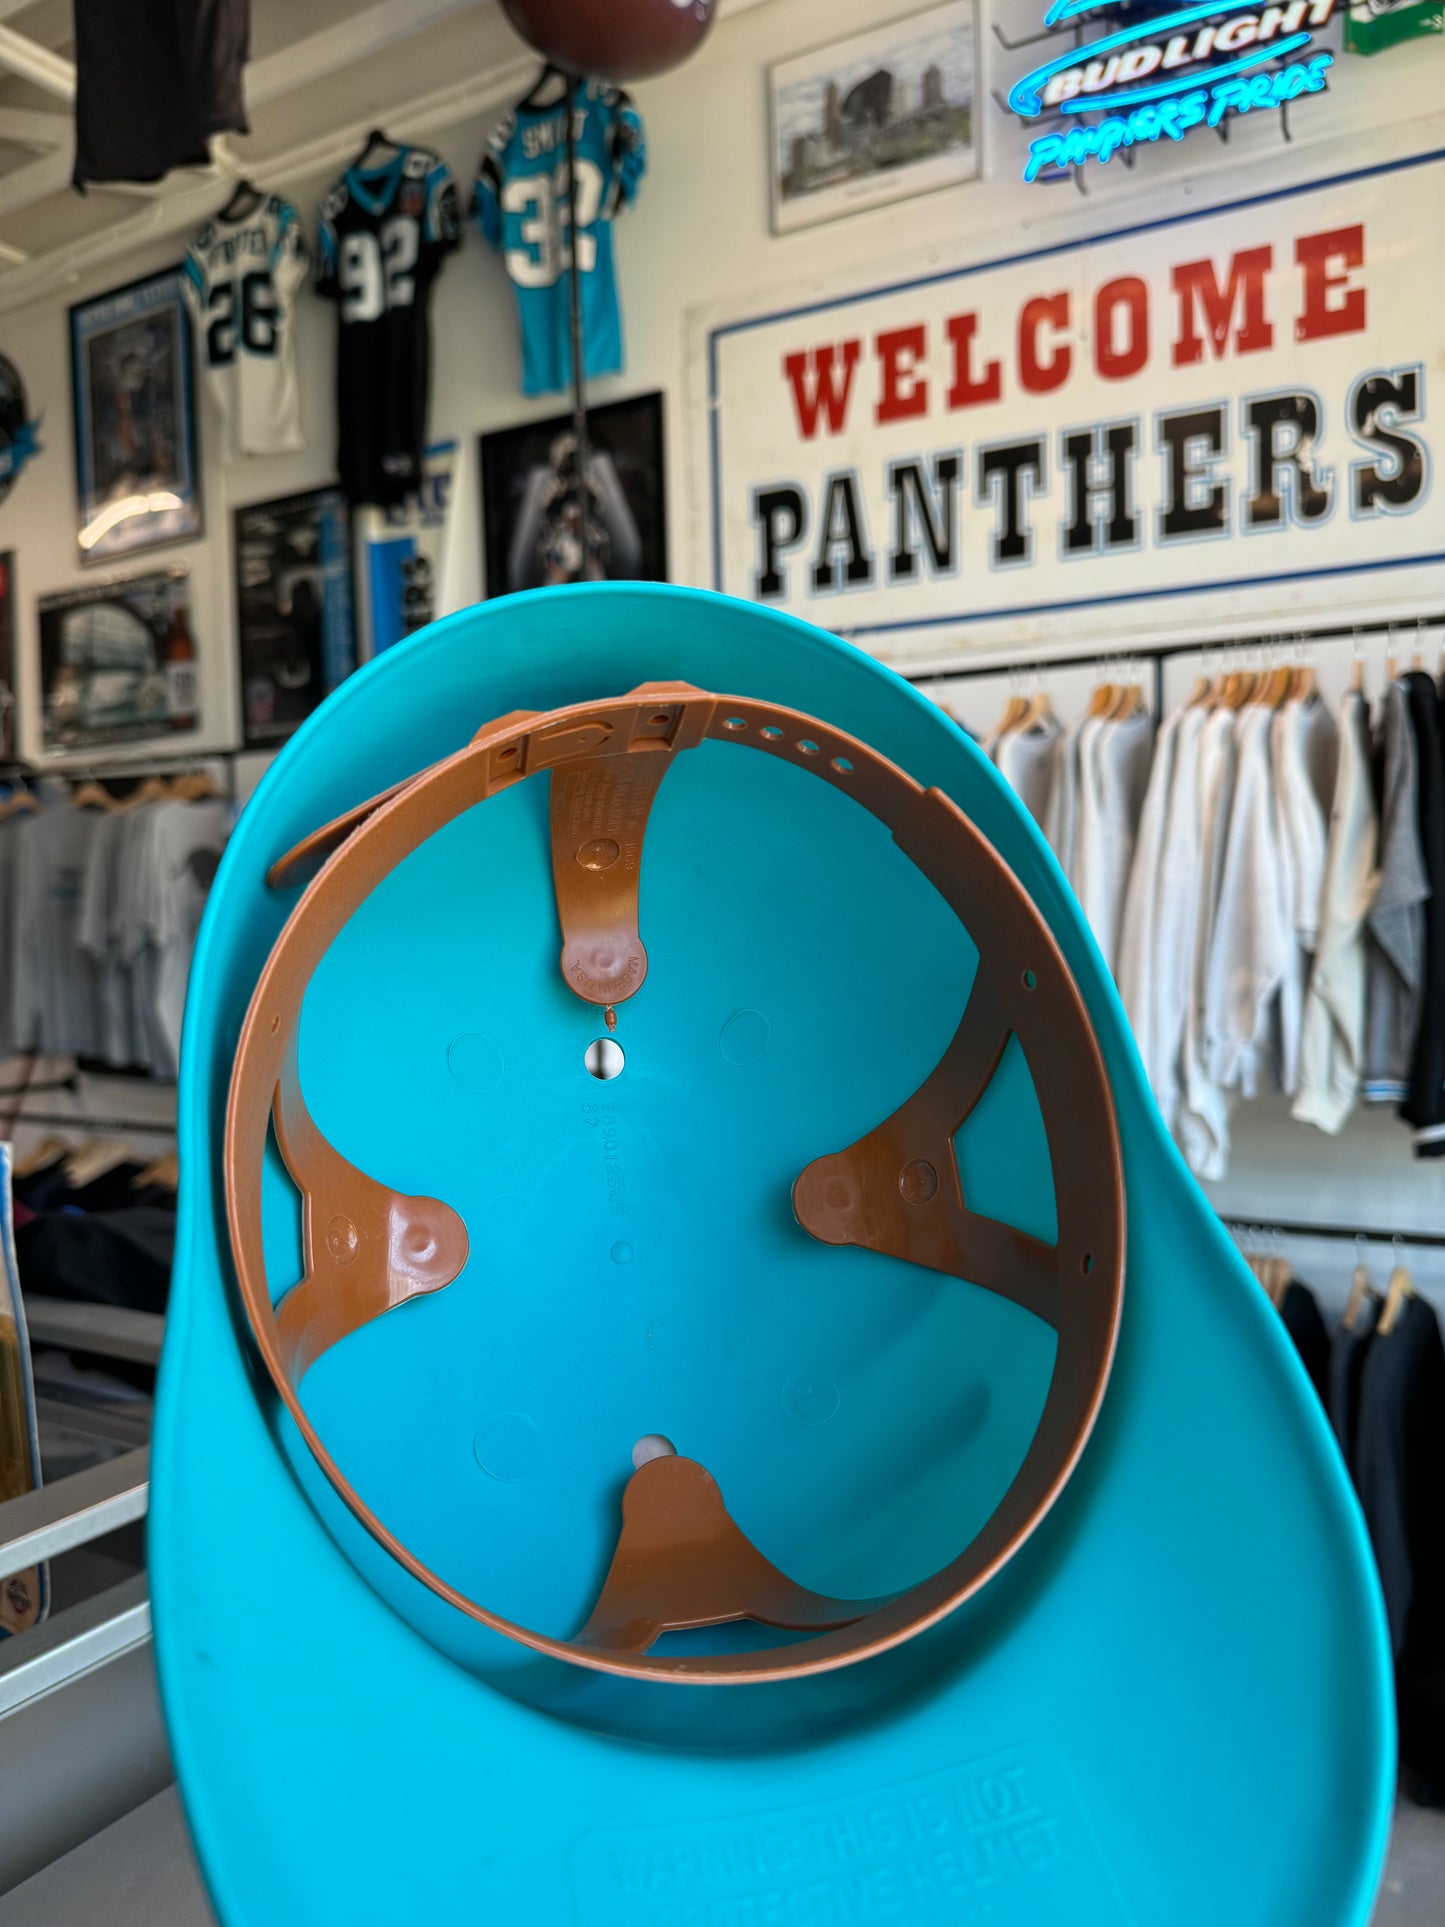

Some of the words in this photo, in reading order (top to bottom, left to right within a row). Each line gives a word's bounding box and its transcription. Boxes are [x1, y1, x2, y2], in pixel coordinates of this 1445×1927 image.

[341, 215, 420, 324] 92
[504, 158, 603, 288] 32
[207, 271, 280, 366] 26
[783, 223, 1368, 442] WELCOME
[750, 361, 1432, 600] PANTHERS
[598, 983, 611, 994] IN
[614, 955, 640, 991] MADE
[798, 1807, 898, 1864] THIS
[903, 1793, 949, 1840] IS
[955, 1765, 1026, 1825] NOT
[903, 1819, 1062, 1907] HELMET
